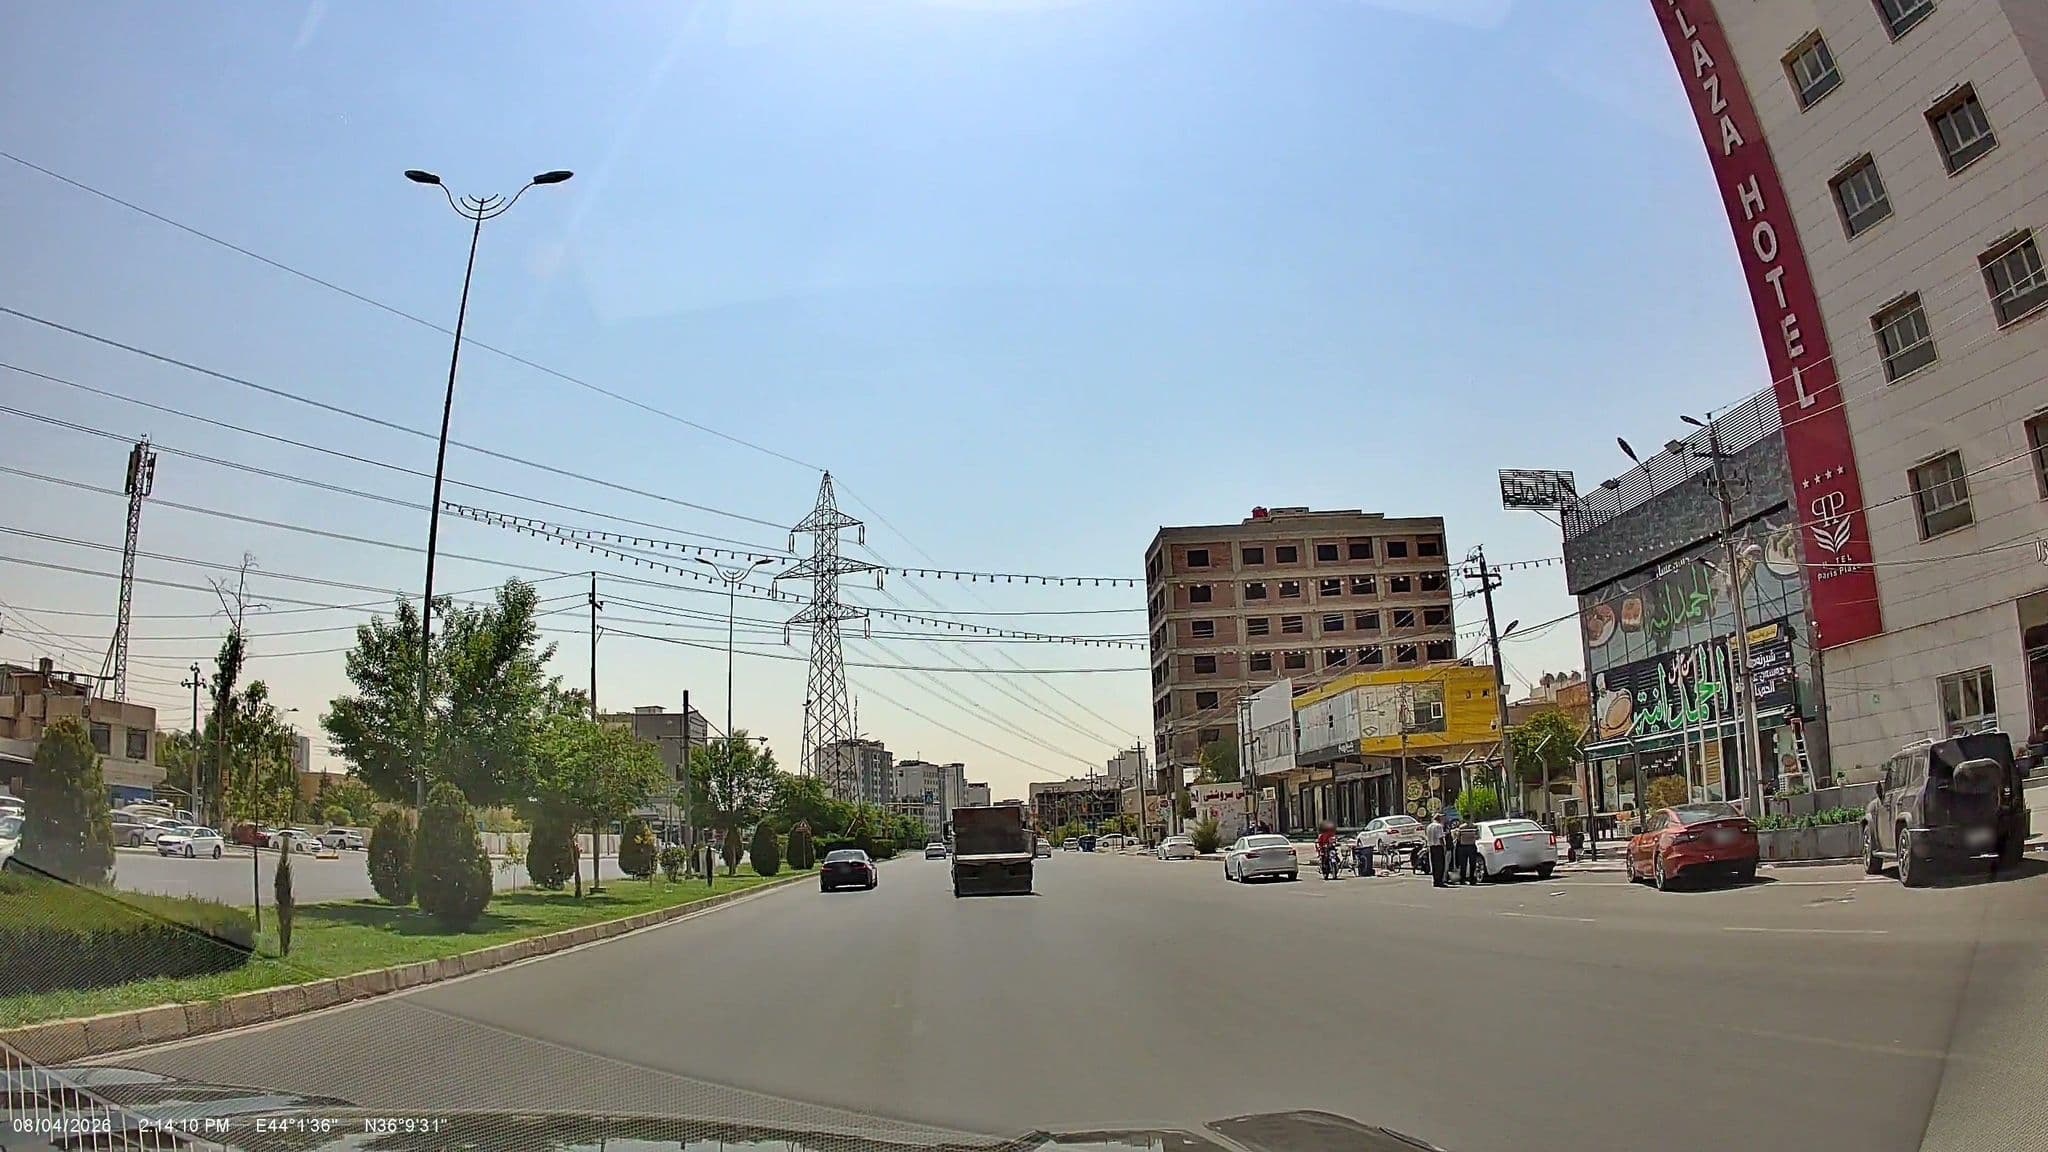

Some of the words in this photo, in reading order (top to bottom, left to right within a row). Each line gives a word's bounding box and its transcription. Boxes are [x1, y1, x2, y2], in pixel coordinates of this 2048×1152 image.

[1668, 0, 1744, 156] LAZA
[1737, 174, 1815, 410] HOTEL
[1822, 553, 1852, 569] HTEL
